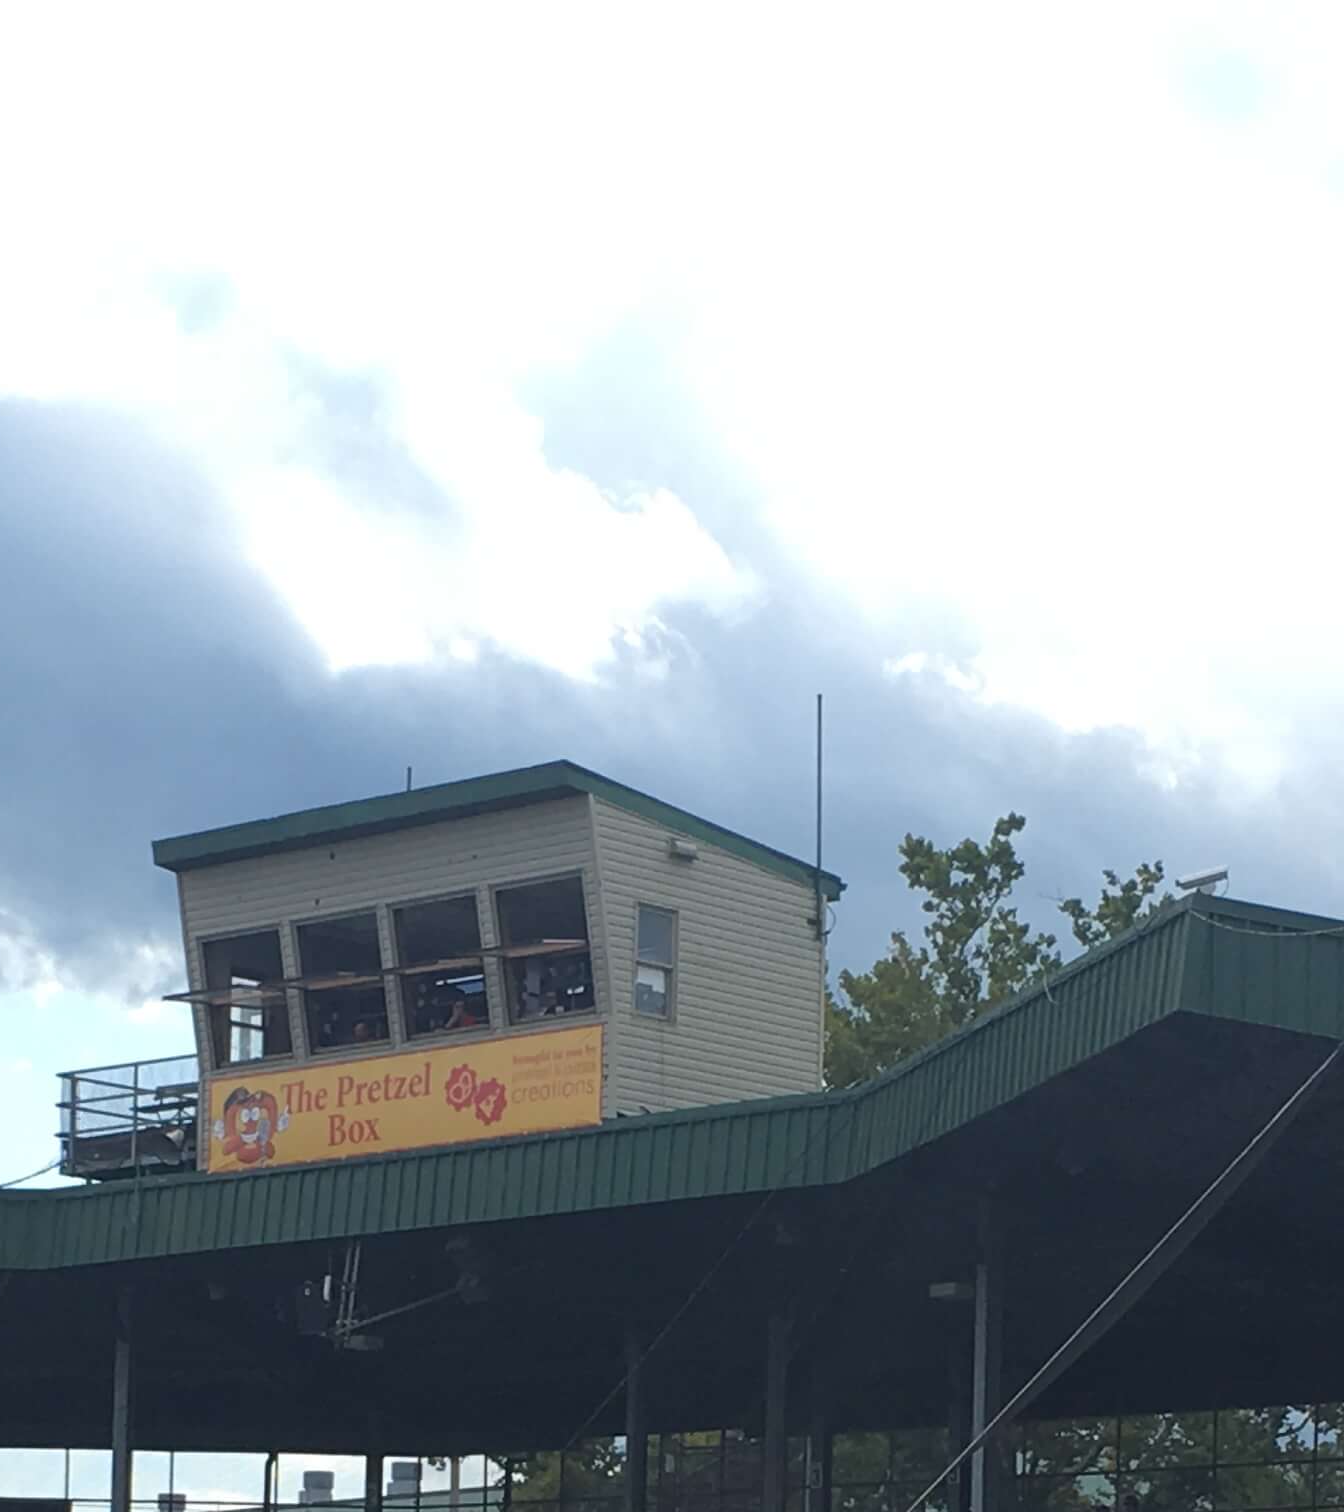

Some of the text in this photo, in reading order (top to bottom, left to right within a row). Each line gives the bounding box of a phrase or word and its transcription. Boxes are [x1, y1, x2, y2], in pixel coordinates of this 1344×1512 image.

[281, 1061, 432, 1114] The Pretzel
[511, 1078, 595, 1104] creations
[328, 1113, 382, 1147] Box
